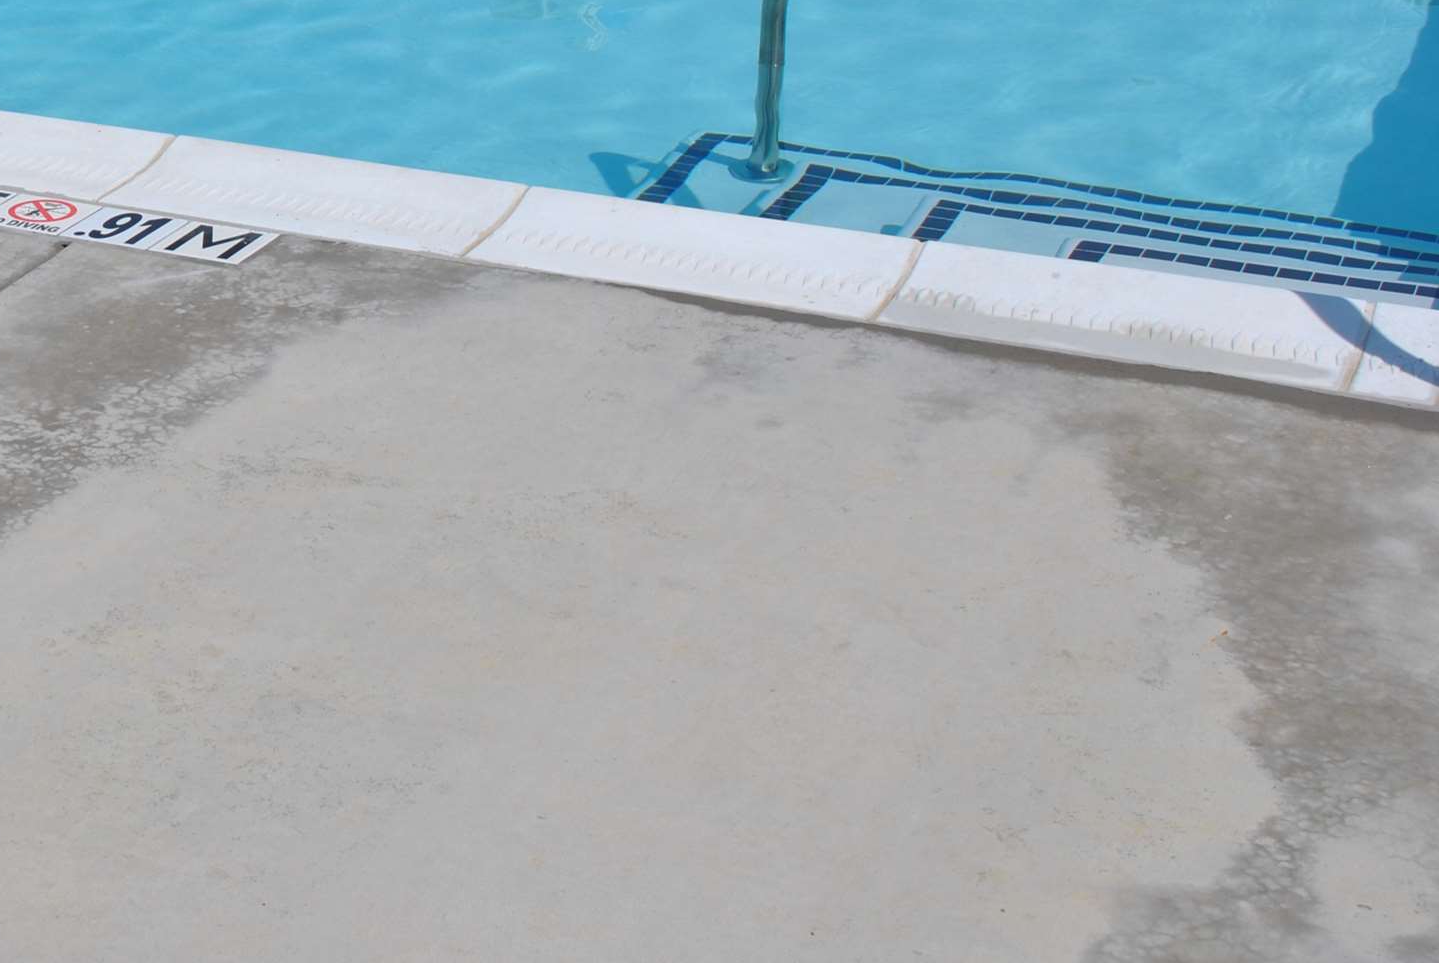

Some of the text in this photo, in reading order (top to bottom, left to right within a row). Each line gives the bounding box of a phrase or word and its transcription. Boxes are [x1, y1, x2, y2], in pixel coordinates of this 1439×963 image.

[6, 219, 61, 234] DIVING
[73, 212, 174, 245] .91
[164, 223, 264, 260] M
